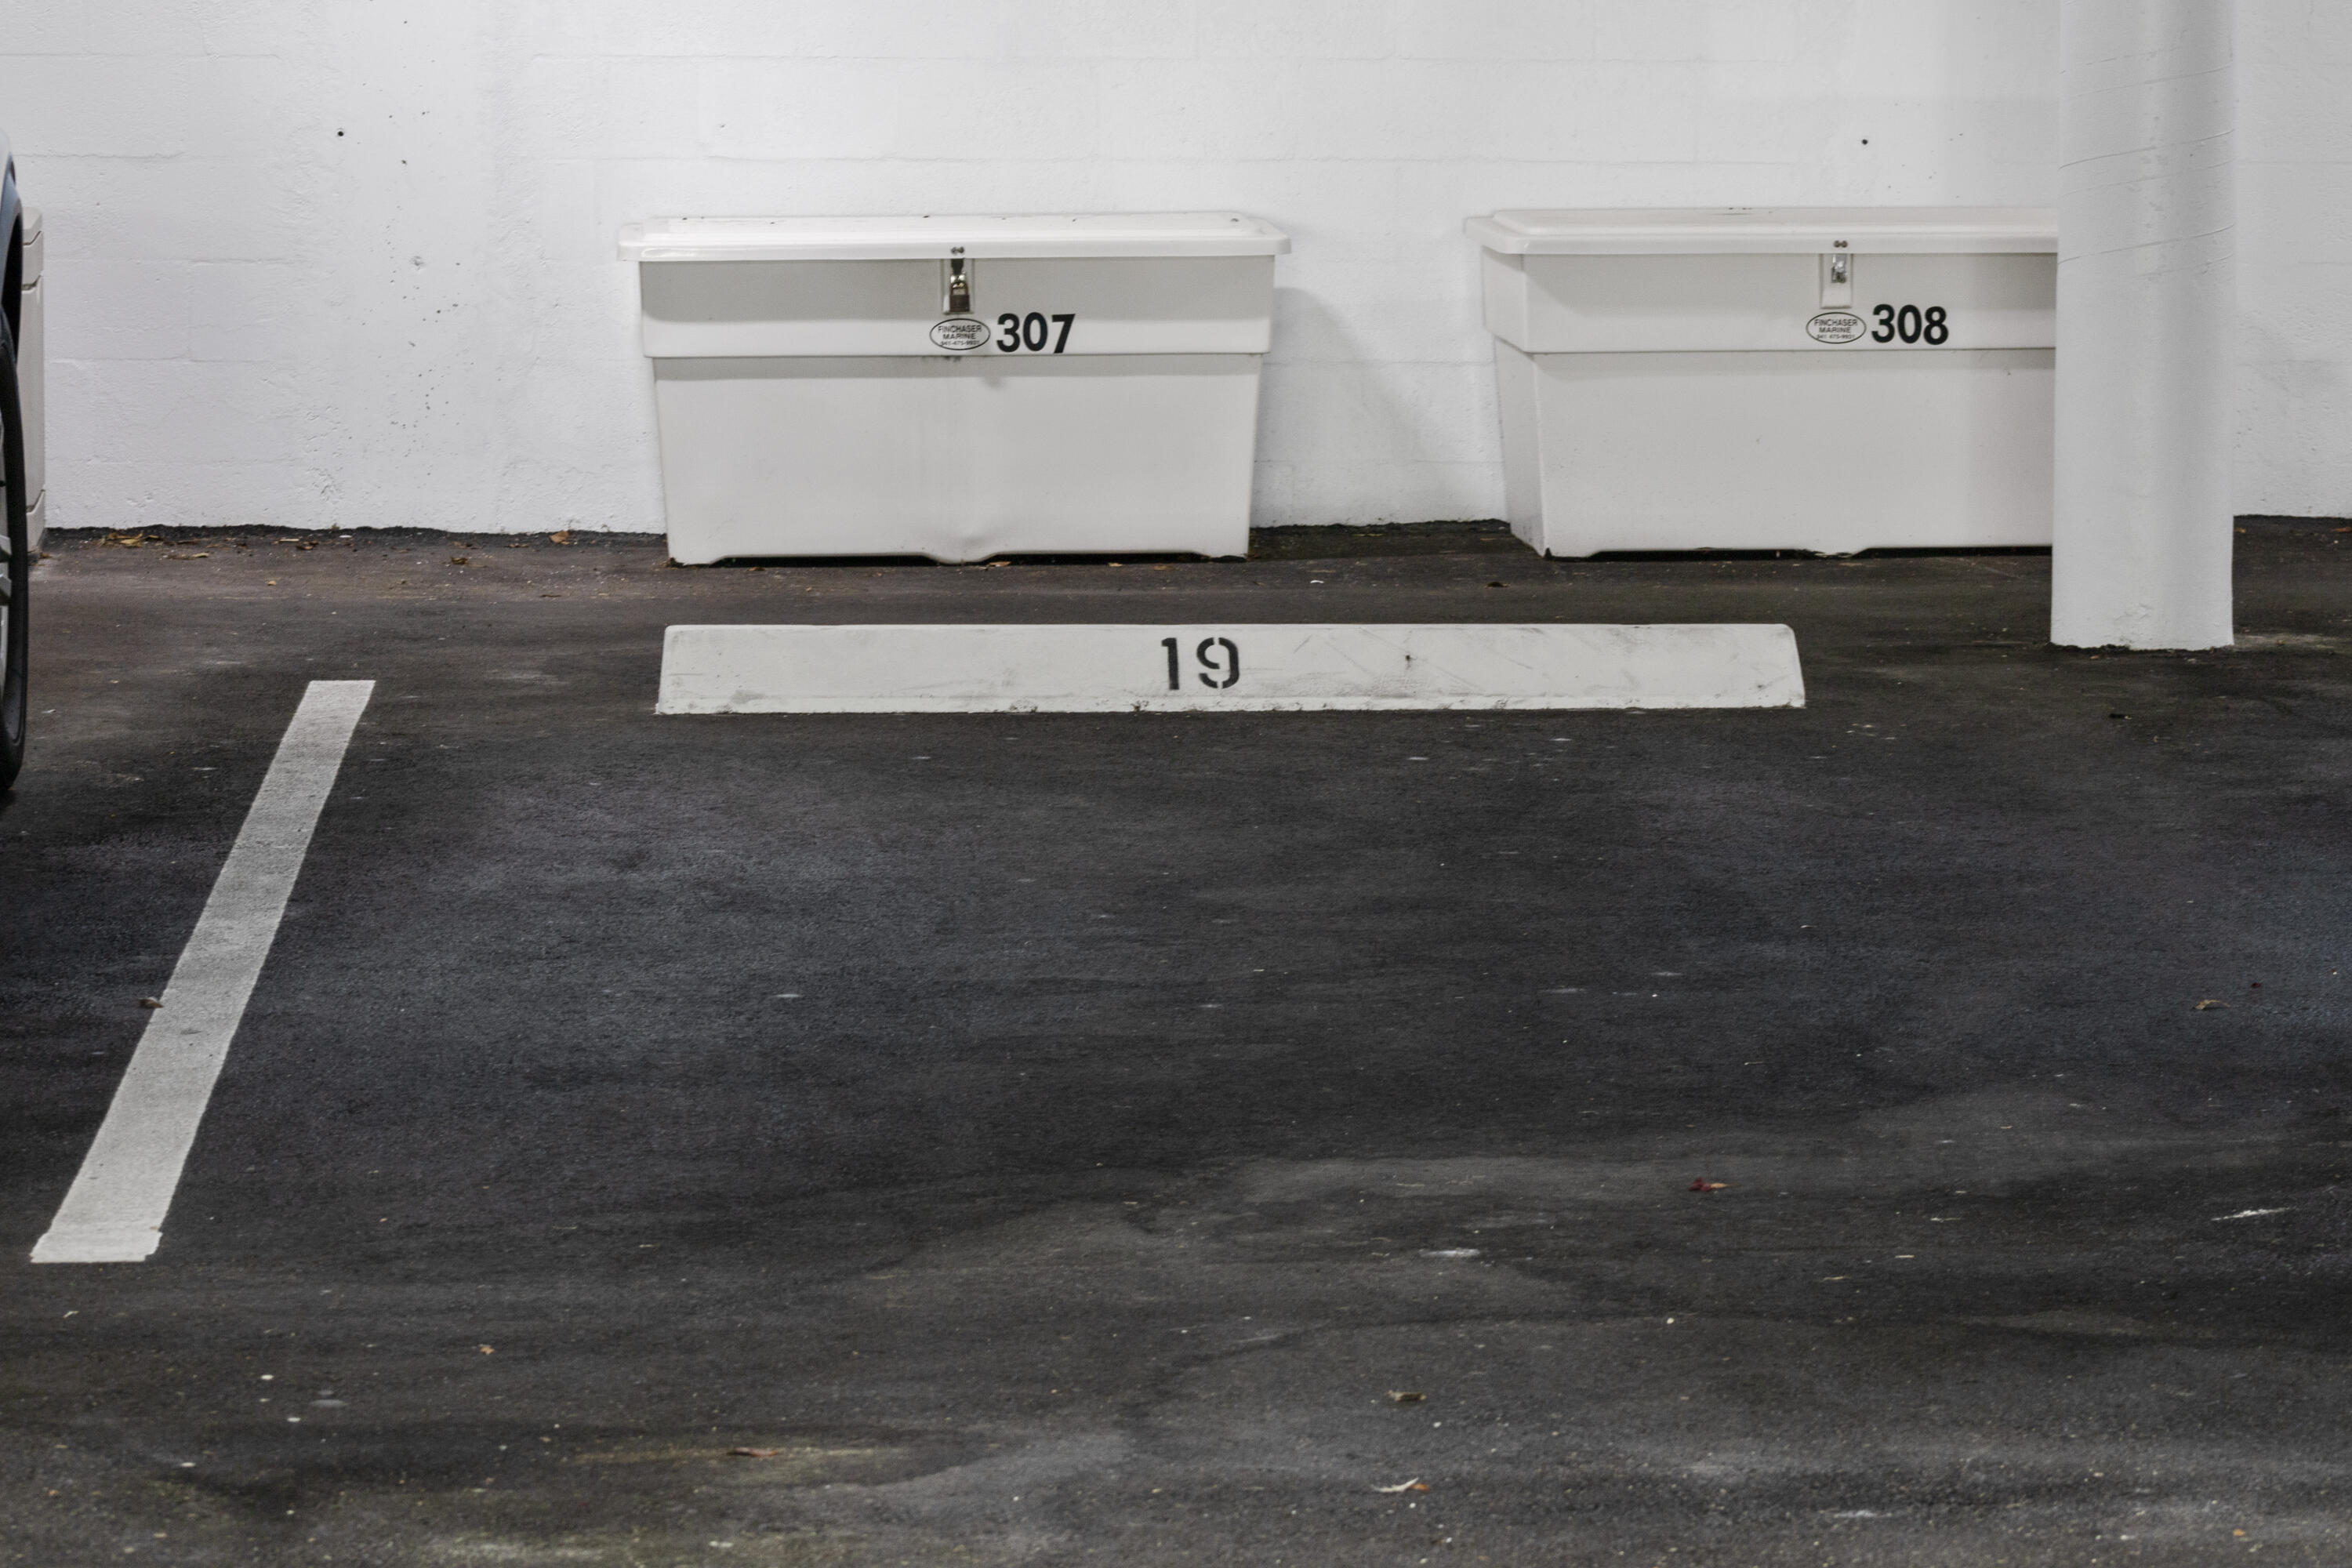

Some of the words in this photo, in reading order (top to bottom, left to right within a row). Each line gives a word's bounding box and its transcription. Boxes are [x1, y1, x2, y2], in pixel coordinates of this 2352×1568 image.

[937, 325, 982, 333] FINCHASER
[996, 312, 1076, 354] 307
[1813, 318, 1858, 327] FINCHASER
[1871, 303, 1949, 345] 308
[1161, 637, 1240, 691] 19
